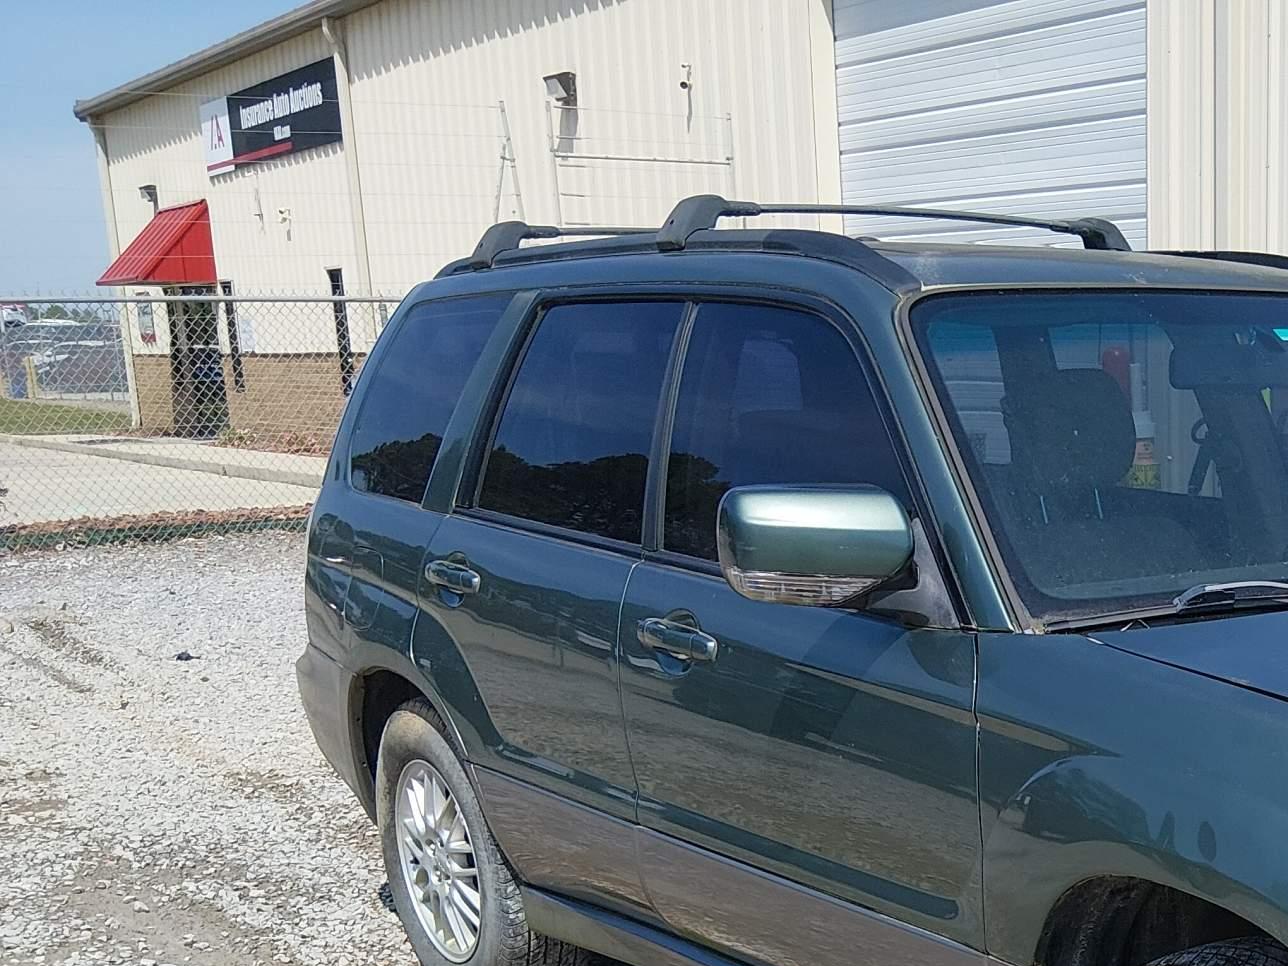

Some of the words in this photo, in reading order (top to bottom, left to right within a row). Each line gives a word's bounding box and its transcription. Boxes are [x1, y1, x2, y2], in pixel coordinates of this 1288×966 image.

[239, 104, 274, 130] Insurance
[272, 92, 290, 119] Auto
[289, 81, 323, 114] Auctions
